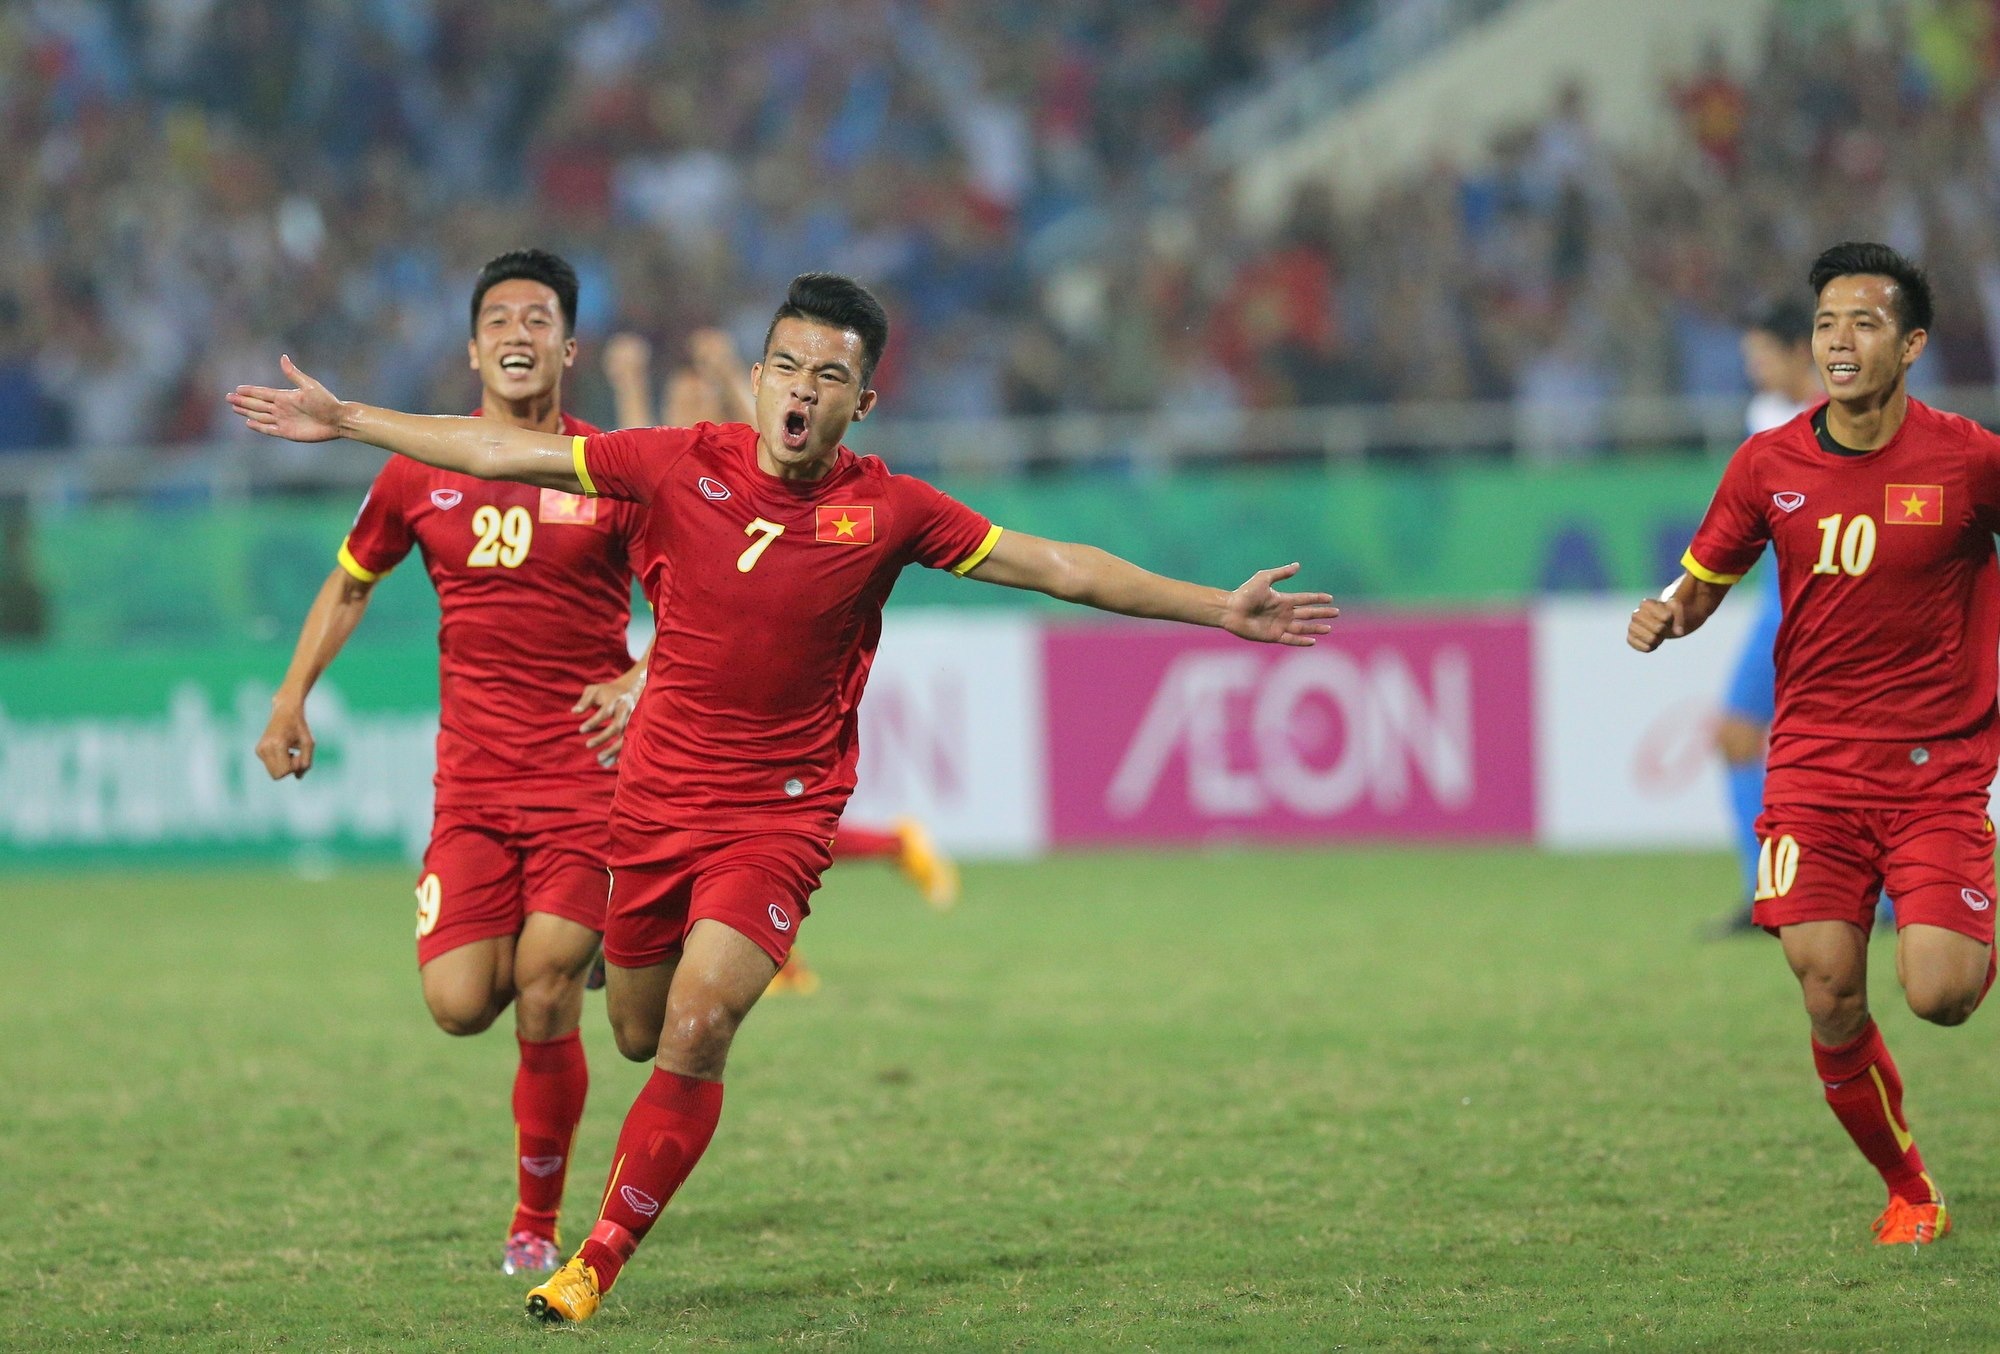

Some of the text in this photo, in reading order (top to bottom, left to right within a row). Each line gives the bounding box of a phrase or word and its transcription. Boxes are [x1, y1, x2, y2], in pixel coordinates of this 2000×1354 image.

[467, 506, 533, 568] 29
[736, 518, 784, 573] 7
[1813, 514, 1876, 576] 10
[1755, 835, 1800, 901] 10
[415, 872, 442, 940] 9
